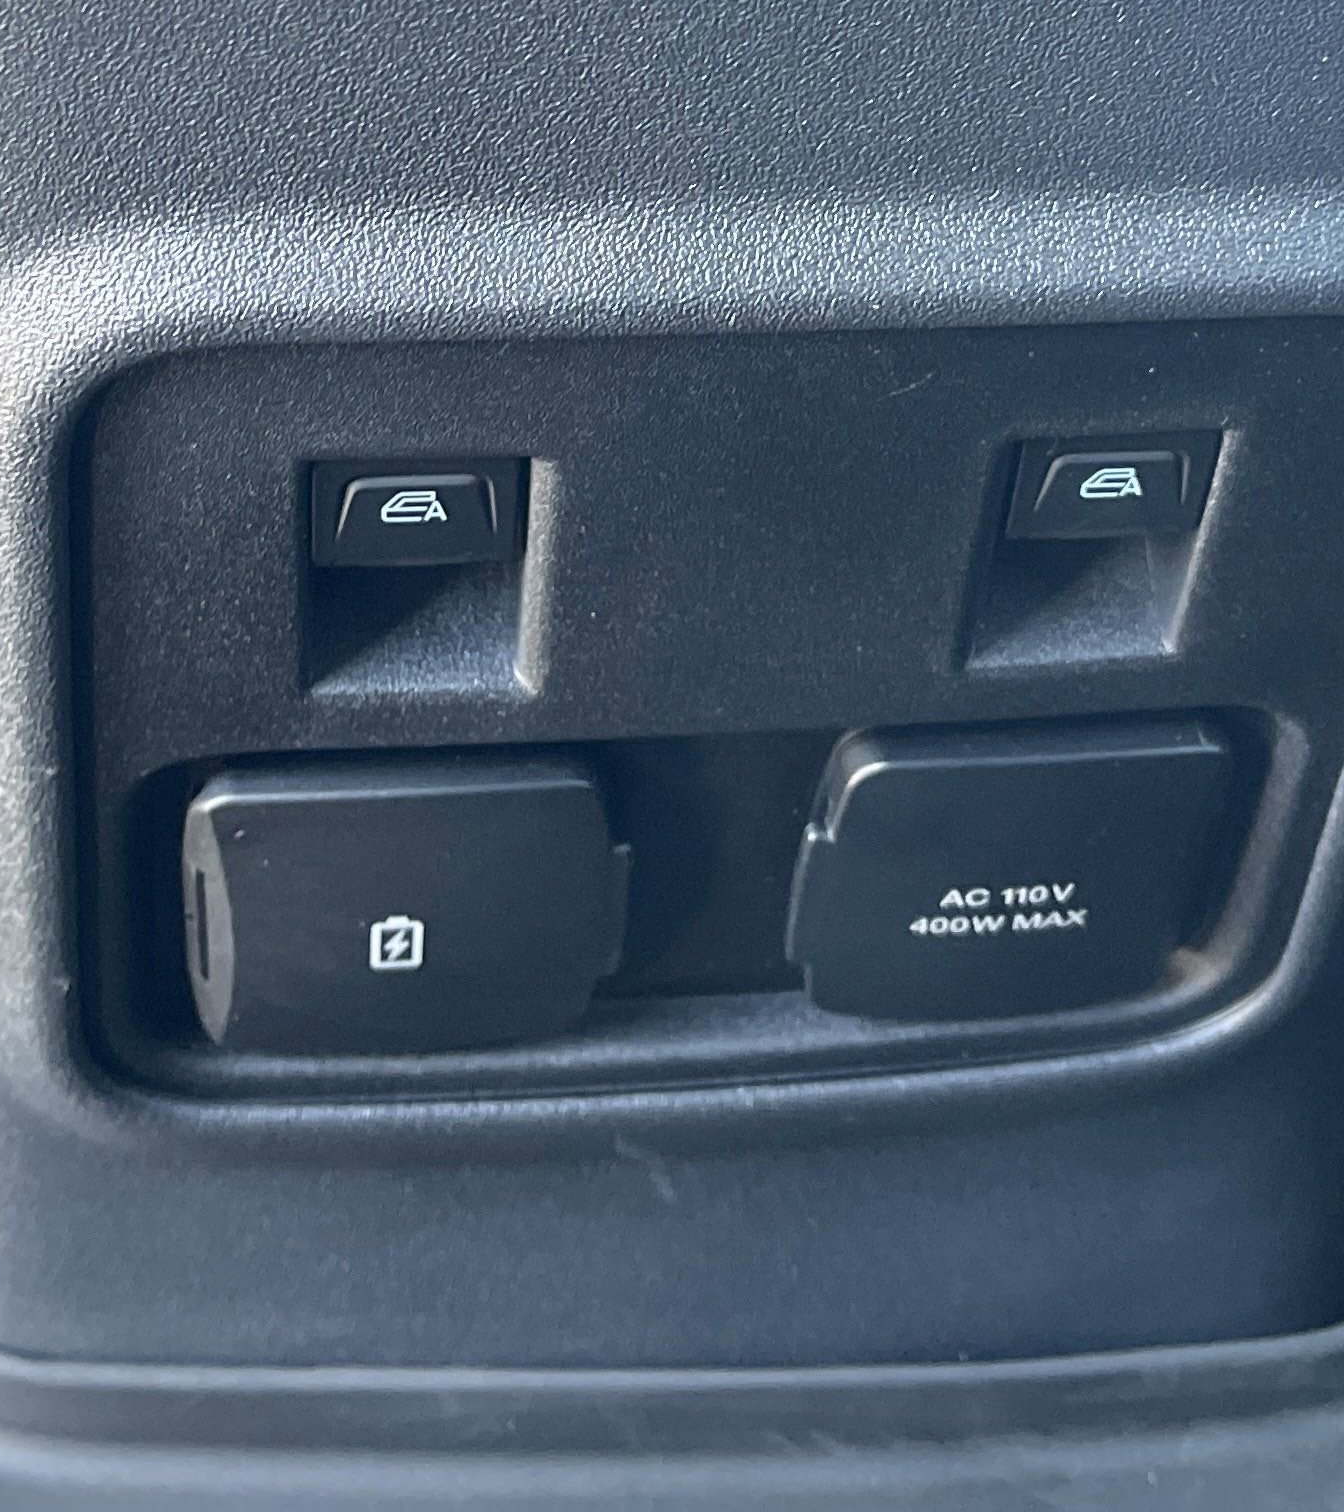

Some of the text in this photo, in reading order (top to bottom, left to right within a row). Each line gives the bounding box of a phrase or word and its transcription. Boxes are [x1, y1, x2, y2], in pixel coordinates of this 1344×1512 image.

[939, 883, 1076, 909] AC 110V
[909, 908, 1089, 936] 400W MAX
